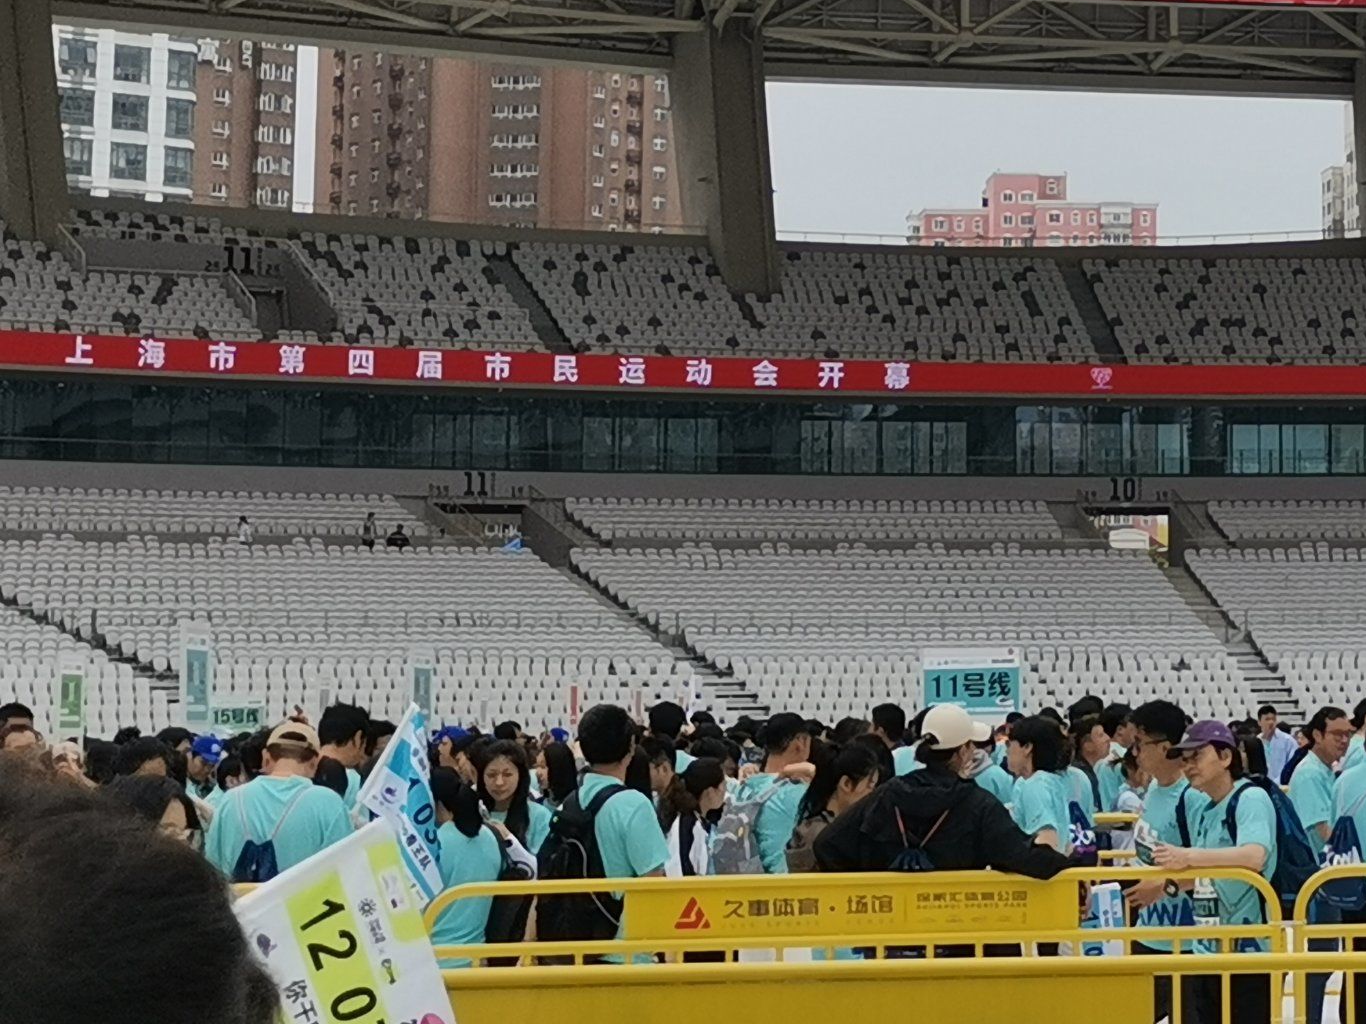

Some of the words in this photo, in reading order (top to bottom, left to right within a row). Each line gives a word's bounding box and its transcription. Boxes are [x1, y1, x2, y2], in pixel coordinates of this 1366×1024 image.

[223, 246, 254, 275] 11
[65, 335, 910, 390] 上海市第四届市民运动会开幕
[464, 471, 488, 496] 11
[1110, 476, 1136, 502] 10
[931, 671, 1011, 698] 11号线
[300, 899, 386, 1024] 120
